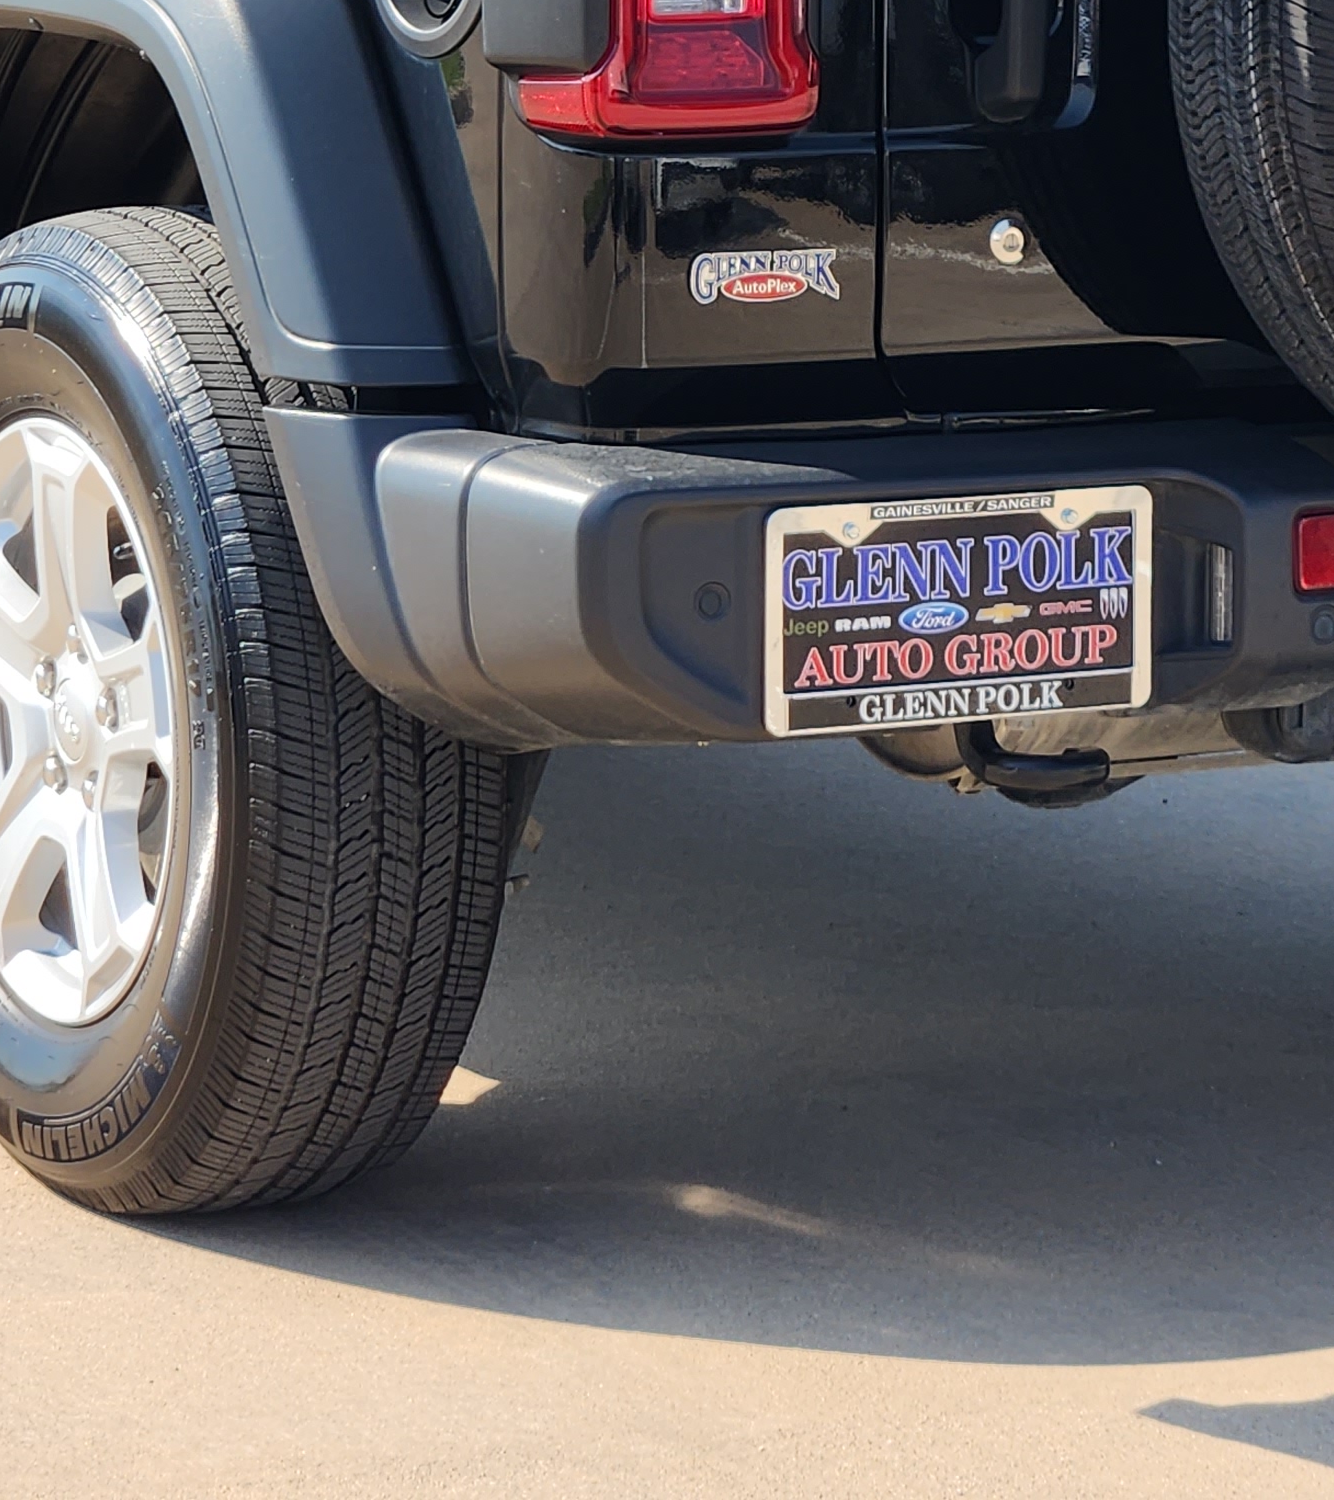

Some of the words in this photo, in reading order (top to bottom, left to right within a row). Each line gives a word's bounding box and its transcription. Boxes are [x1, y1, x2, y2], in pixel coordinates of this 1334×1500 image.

[694, 254, 767, 301] GLENN
[777, 252, 836, 293] POLK
[732, 278, 797, 295] AutoPlex
[782, 538, 975, 611] GLENN
[983, 526, 1133, 596] POLK
[783, 616, 829, 638] Jeep
[835, 615, 892, 633] RAM
[911, 607, 955, 630] Ford
[1040, 599, 1093, 616] GMC
[794, 638, 934, 689] AUTO
[944, 624, 1117, 677] GROUP
[859, 687, 971, 724] GLENN
[976, 680, 1064, 715] POLK
[22, 1067, 152, 1162] MICHELIN
